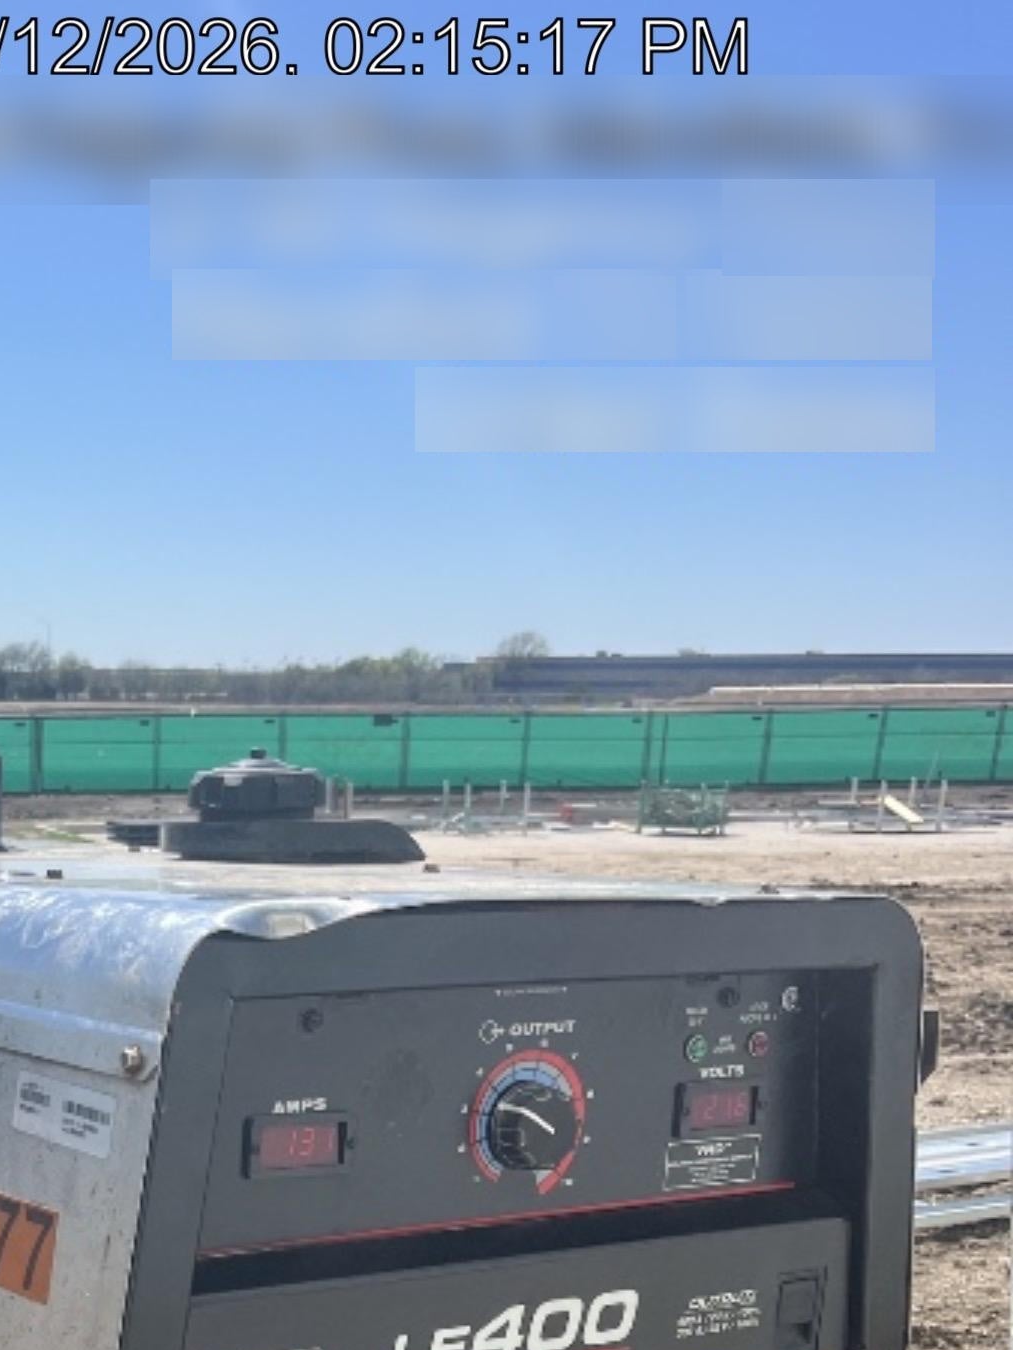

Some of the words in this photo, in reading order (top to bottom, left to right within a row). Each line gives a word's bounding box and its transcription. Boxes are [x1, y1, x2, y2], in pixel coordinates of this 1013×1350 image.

[509, 1020, 576, 1036] OUTPUT
[700, 1064, 745, 1079] VOLTS
[271, 1097, 328, 1114] AMPS
